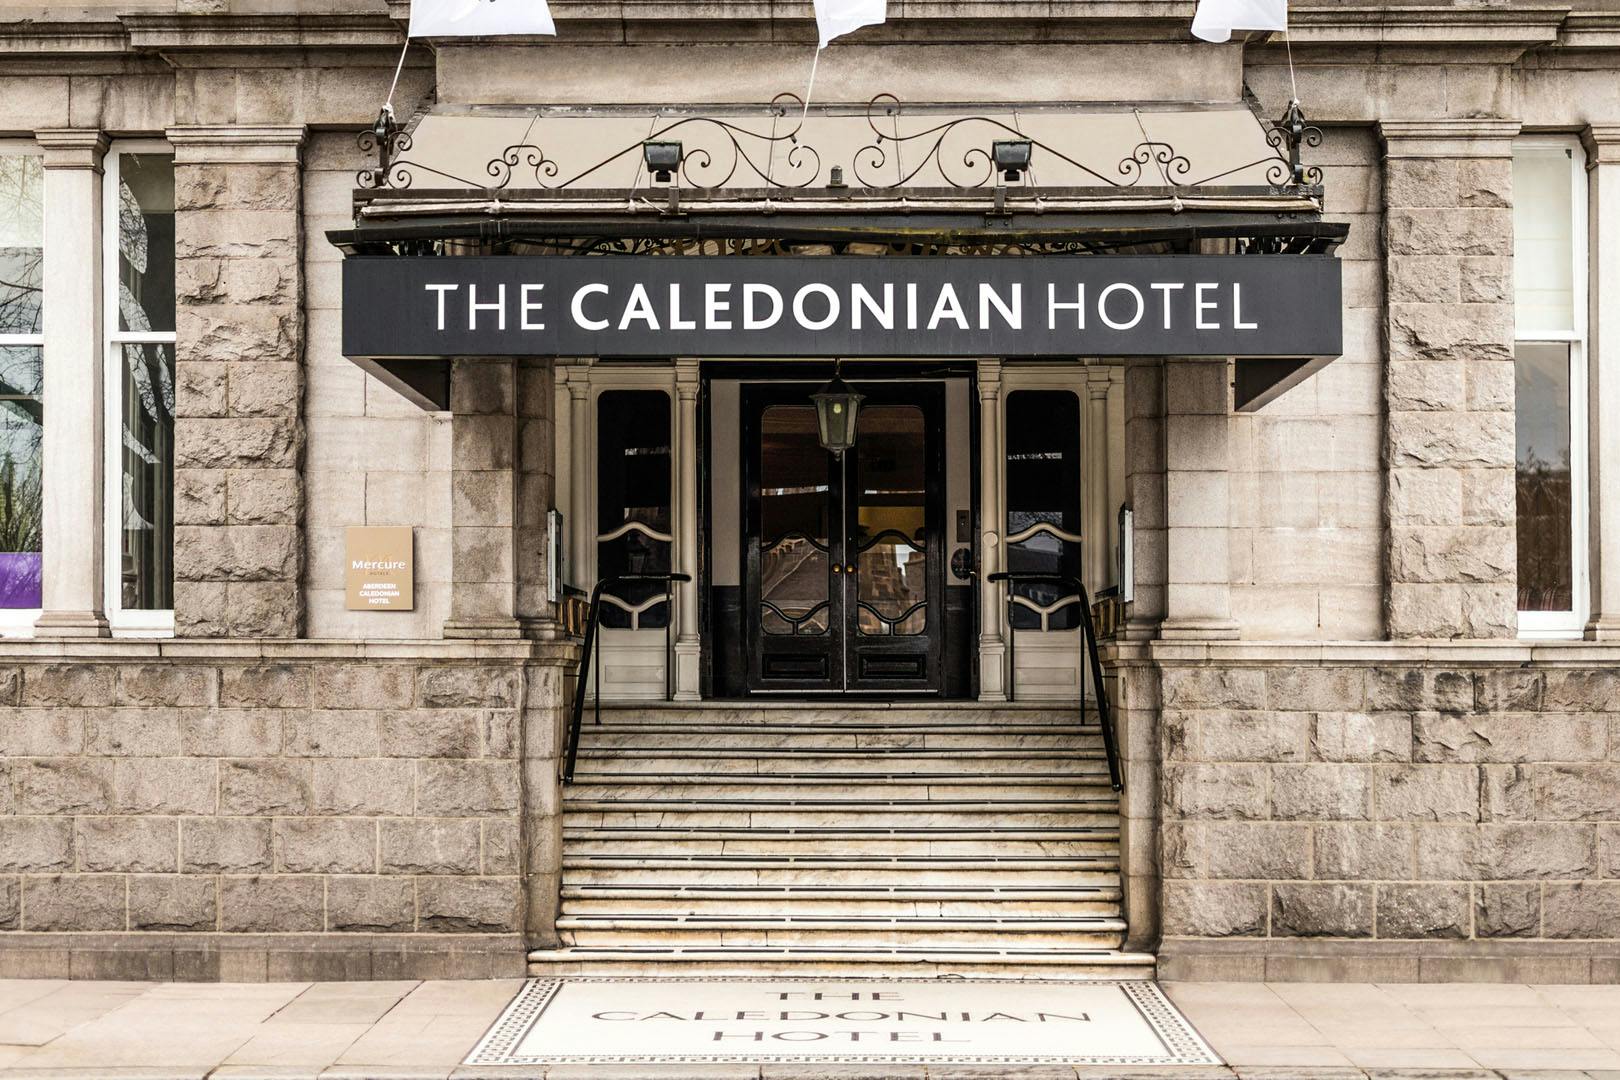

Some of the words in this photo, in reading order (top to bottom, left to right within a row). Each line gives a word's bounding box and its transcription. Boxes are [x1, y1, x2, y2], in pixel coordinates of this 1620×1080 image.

[424, 283, 545, 331] THE
[570, 282, 1022, 331] CALEDONIAN
[1047, 282, 1258, 331] HOTEL
[352, 560, 406, 570] Mercure
[765, 992, 904, 1001] THE
[592, 1011, 1091, 1022] CALEDONIAN
[713, 1032, 972, 1042] HOTEL
